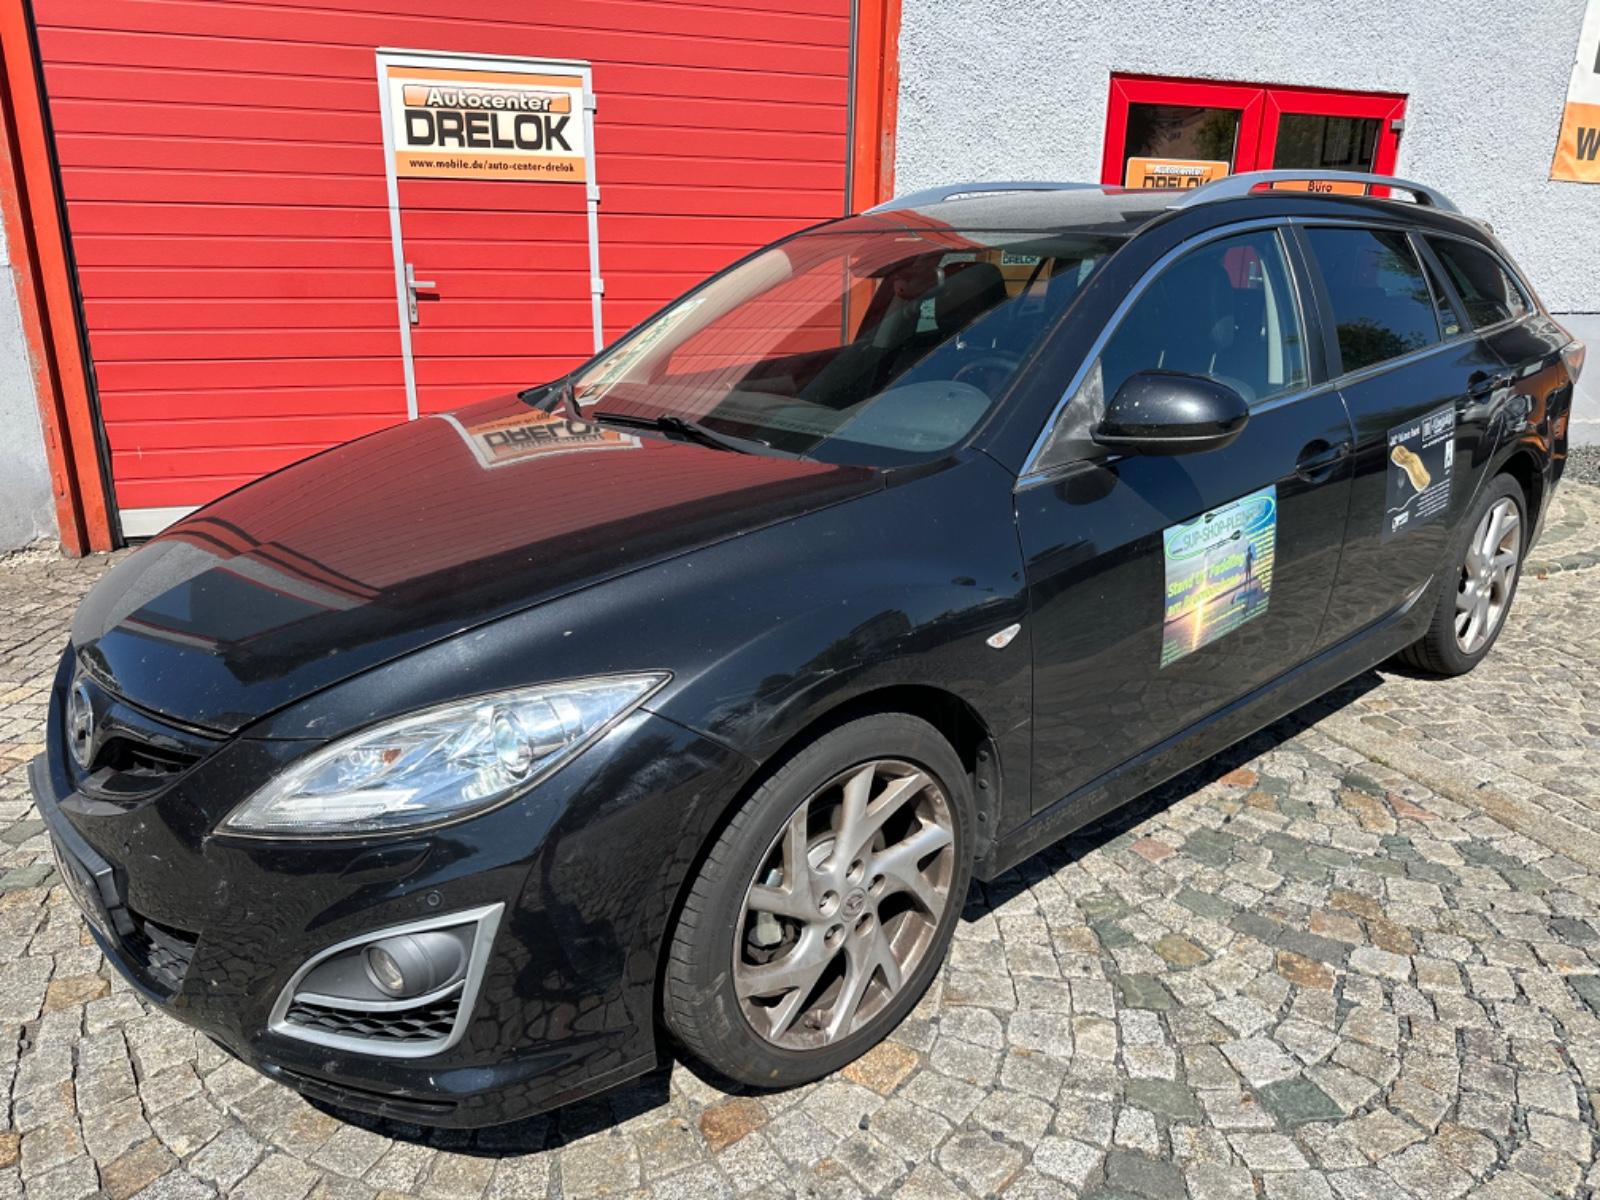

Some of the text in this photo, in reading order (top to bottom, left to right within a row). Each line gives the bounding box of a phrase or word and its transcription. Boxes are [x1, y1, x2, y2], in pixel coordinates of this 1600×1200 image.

[427, 87, 552, 112] Autocenter
[404, 109, 573, 151] DRELOK
[408, 158, 575, 173] www.mobile.de/auto-center-drelok
[1307, 180, 1333, 192] Büro
